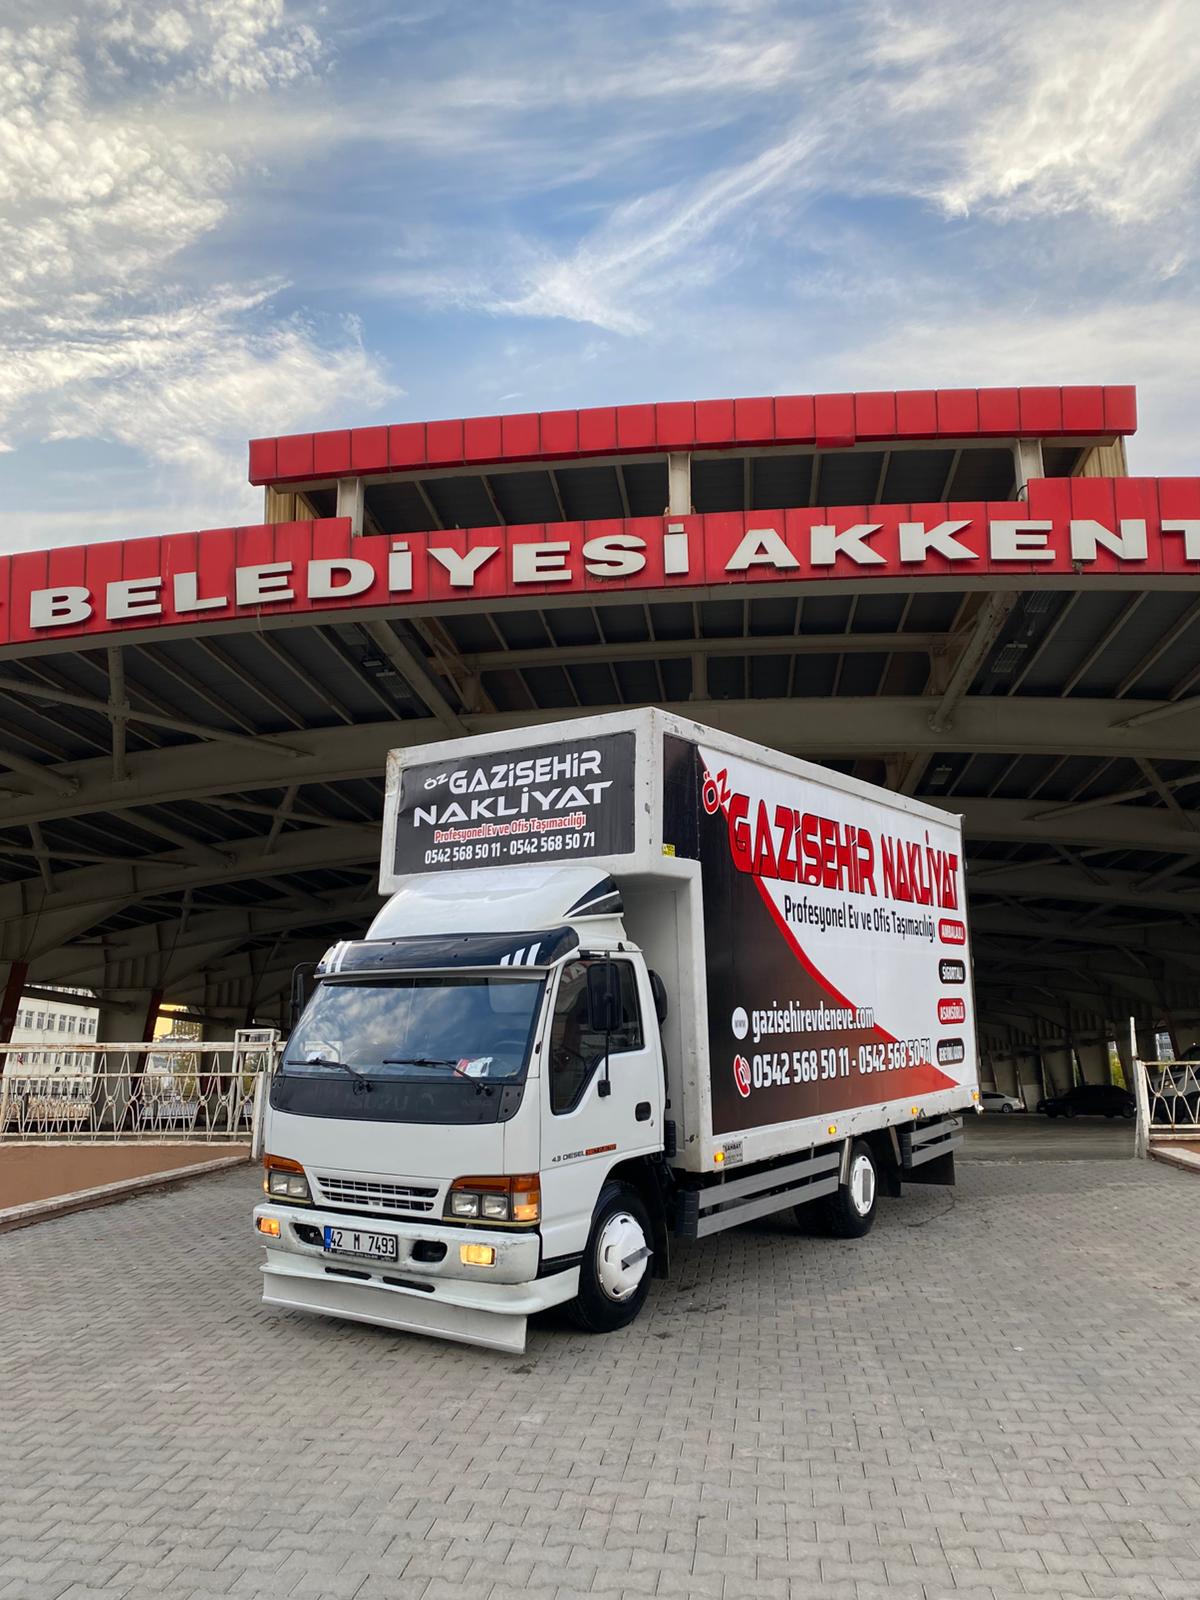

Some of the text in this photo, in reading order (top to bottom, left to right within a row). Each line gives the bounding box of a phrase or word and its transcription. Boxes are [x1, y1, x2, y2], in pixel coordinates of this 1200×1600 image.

[30, 524, 689, 628] BELEDİYESİ
[424, 772, 449, 790] ÖZ
[413, 781, 613, 827] NAKLİYAT
[425, 849, 450, 864] 0542
[452, 846, 473, 861] 568
[475, 844, 488, 859] 50
[490, 842, 500, 857] 11
[510, 838, 538, 855] 0542
[541, 836, 562, 852] 568
[565, 834, 580, 849] 50
[583, 832, 595, 848] 71
[434, 811, 586, 843] Profesyonel Ev ve Ofis Taşımacılığı
[702, 768, 731, 815] ÖZ
[881, 830, 958, 910] NAKLİYAT
[784, 895, 936, 943] Profesyonel Ev ve Ofis Taşımacılığı
[752, 1001, 874, 1043] gazisehirevdeneve.com
[753, 1050, 790, 1089] 0542
[792, 1049, 818, 1083] 568
[820, 1048, 837, 1080] 50
[839, 1047, 850, 1077] 11
[858, 1043, 886, 1074] 0542
[887, 1040, 907, 1070] 568
[907, 1038, 921, 1067] 50
[921, 1038, 932, 1065] 71
[331, 1231, 395, 1254] 42 M 7493
